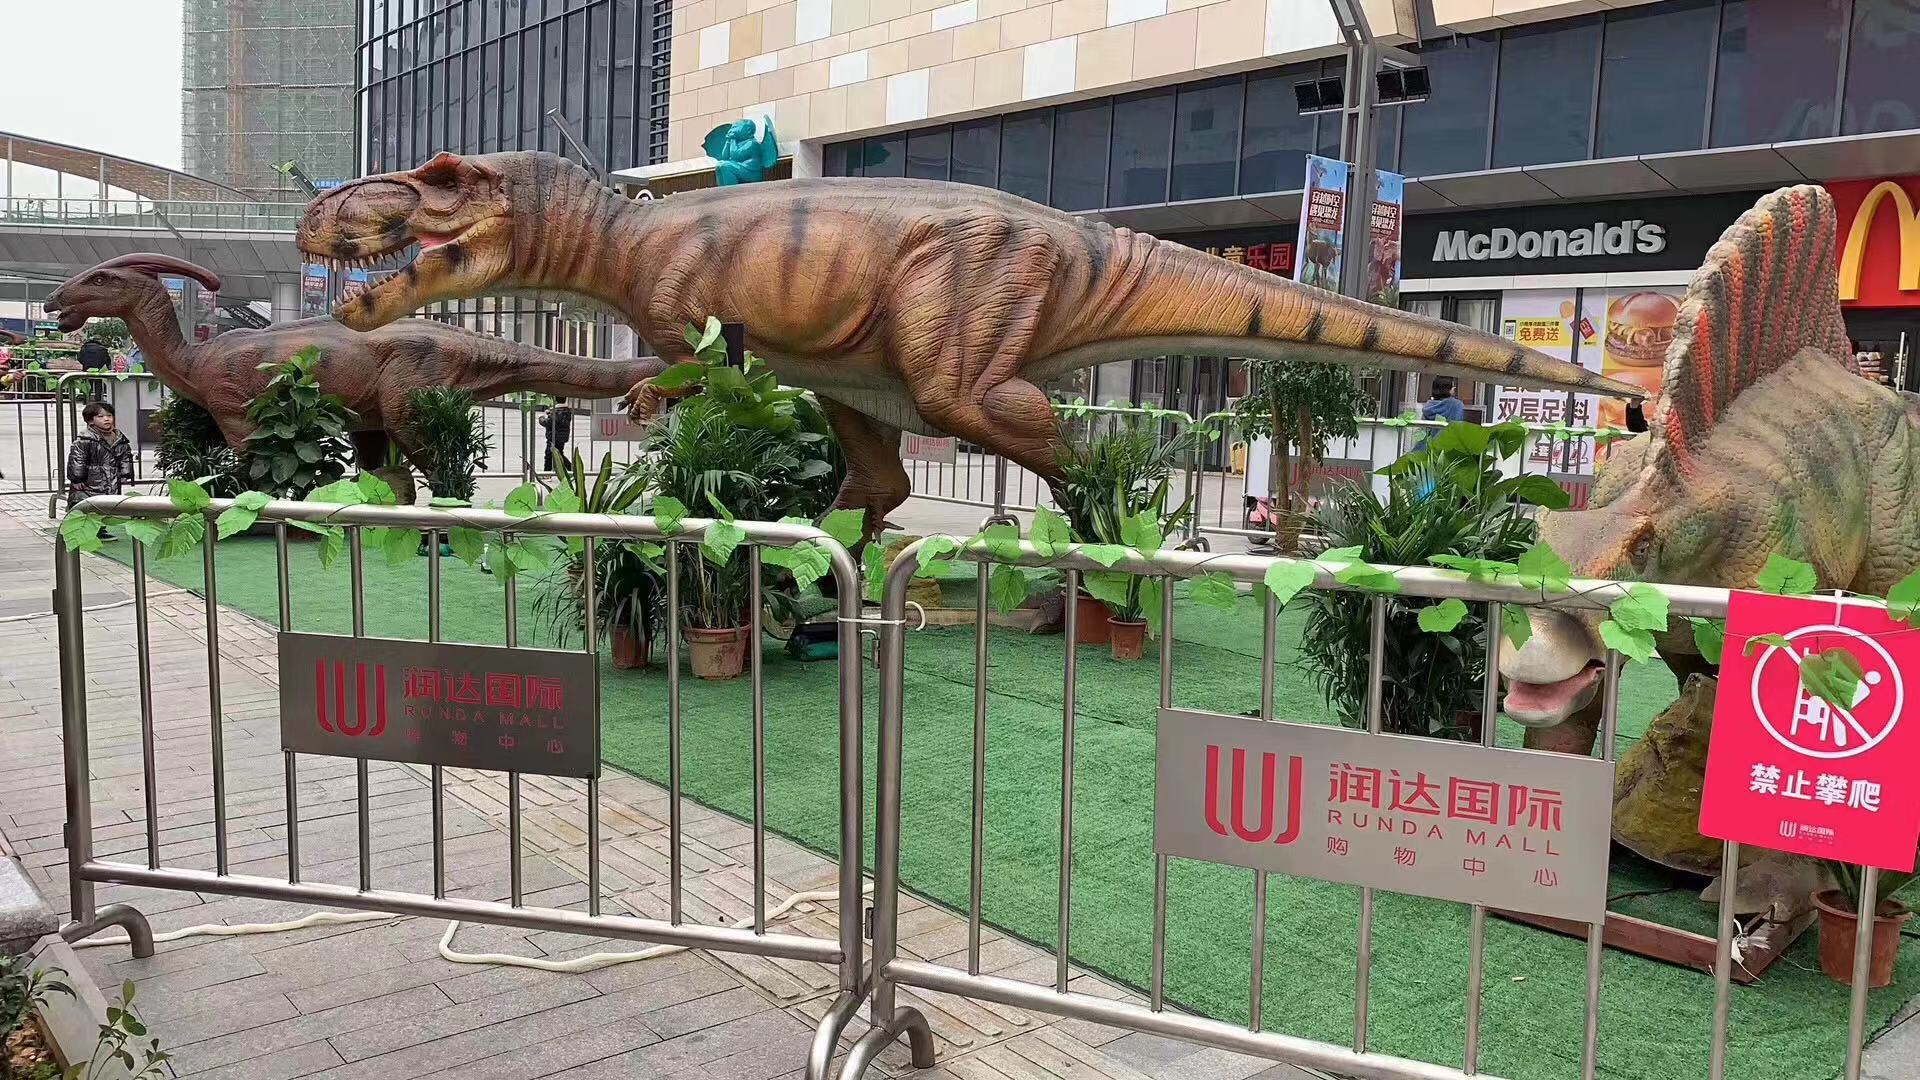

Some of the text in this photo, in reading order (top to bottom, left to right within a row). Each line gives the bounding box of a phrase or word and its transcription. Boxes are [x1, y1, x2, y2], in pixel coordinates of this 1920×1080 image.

[1432, 219, 1667, 262] McDonald's
[1519, 327, 1560, 341] 免费送
[404, 667, 563, 710] 润达国际
[404, 705, 564, 728] RUNDA MALL
[1327, 762, 1562, 832] 润达国际
[1749, 762, 1881, 812] 禁止攀爬
[1328, 809, 1560, 856] RUNDA MALL
[1327, 836, 1558, 887] 购物中心
